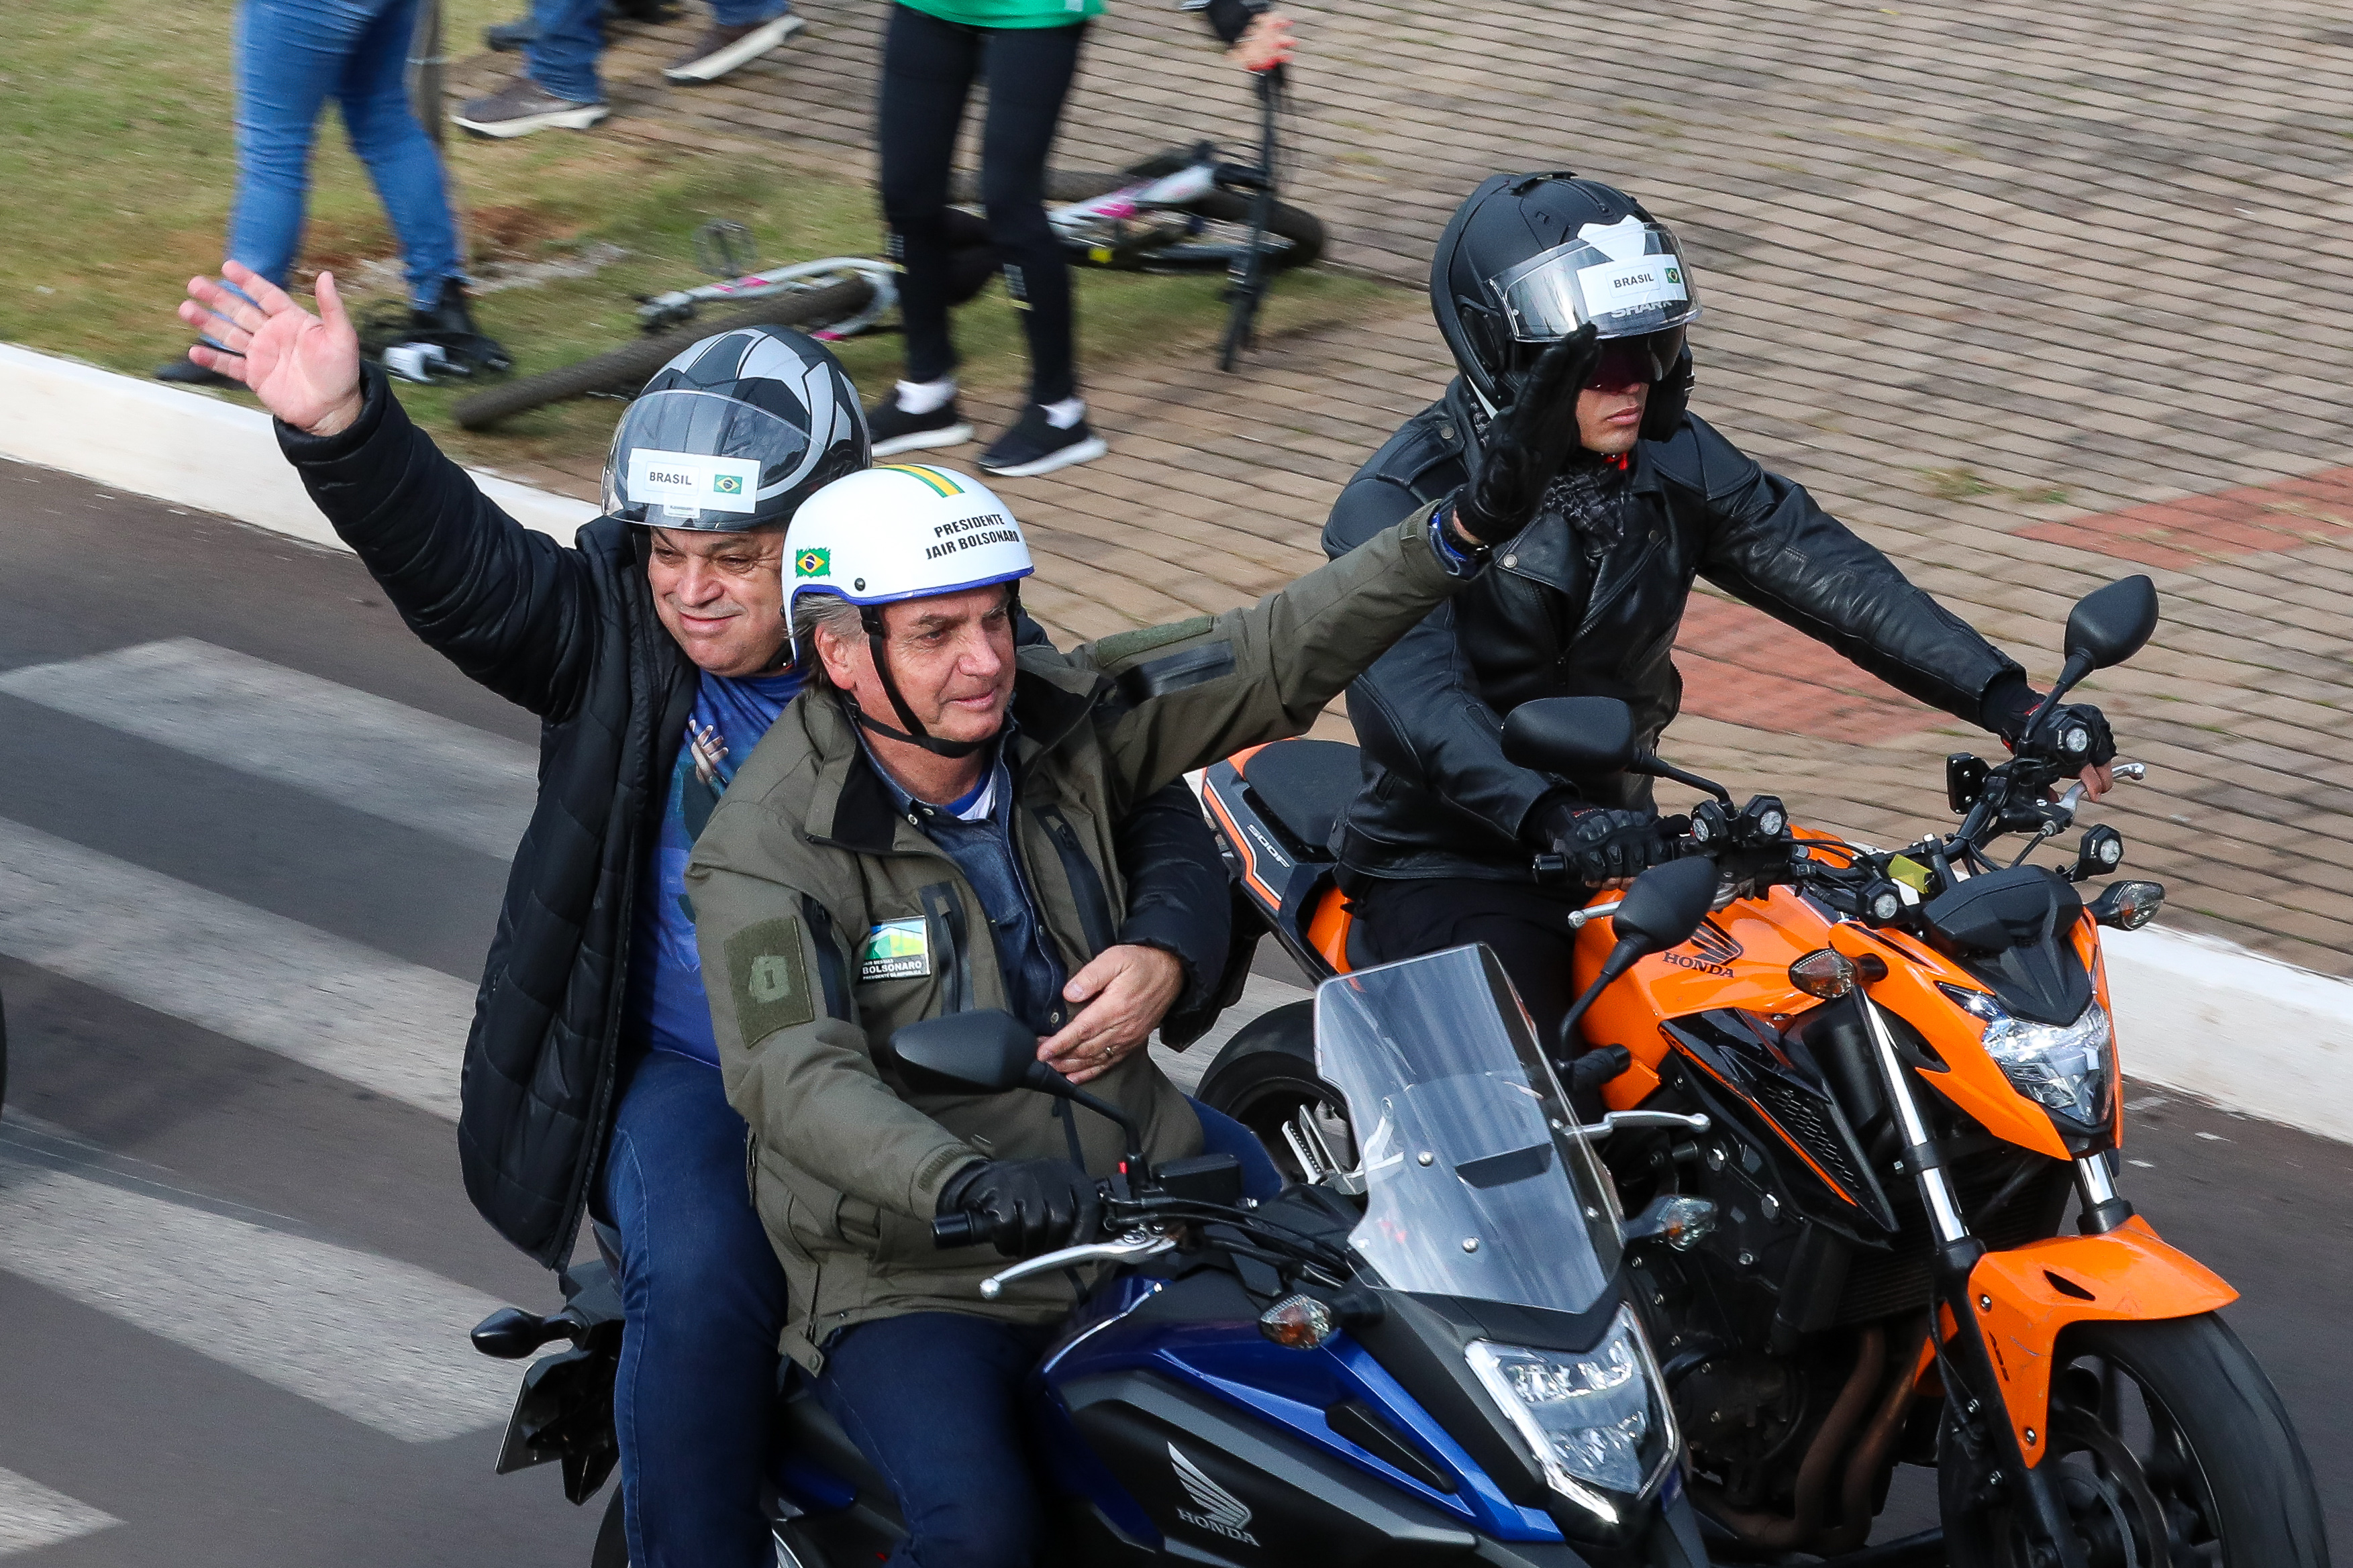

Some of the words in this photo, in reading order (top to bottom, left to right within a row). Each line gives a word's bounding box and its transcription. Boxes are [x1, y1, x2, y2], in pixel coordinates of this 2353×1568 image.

[1613, 273, 1654, 288] BRASIL
[650, 472, 692, 485] BRASIL
[934, 514, 1005, 537] PRESIDENTE
[925, 541, 956, 560] JAIR
[958, 529, 1019, 550] BOLSONARO
[1247, 824, 1291, 868] 500F
[862, 961, 922, 974] BOLSONARO
[1662, 951, 1734, 978] HONDA
[1176, 1508, 1260, 1547] HONDA
